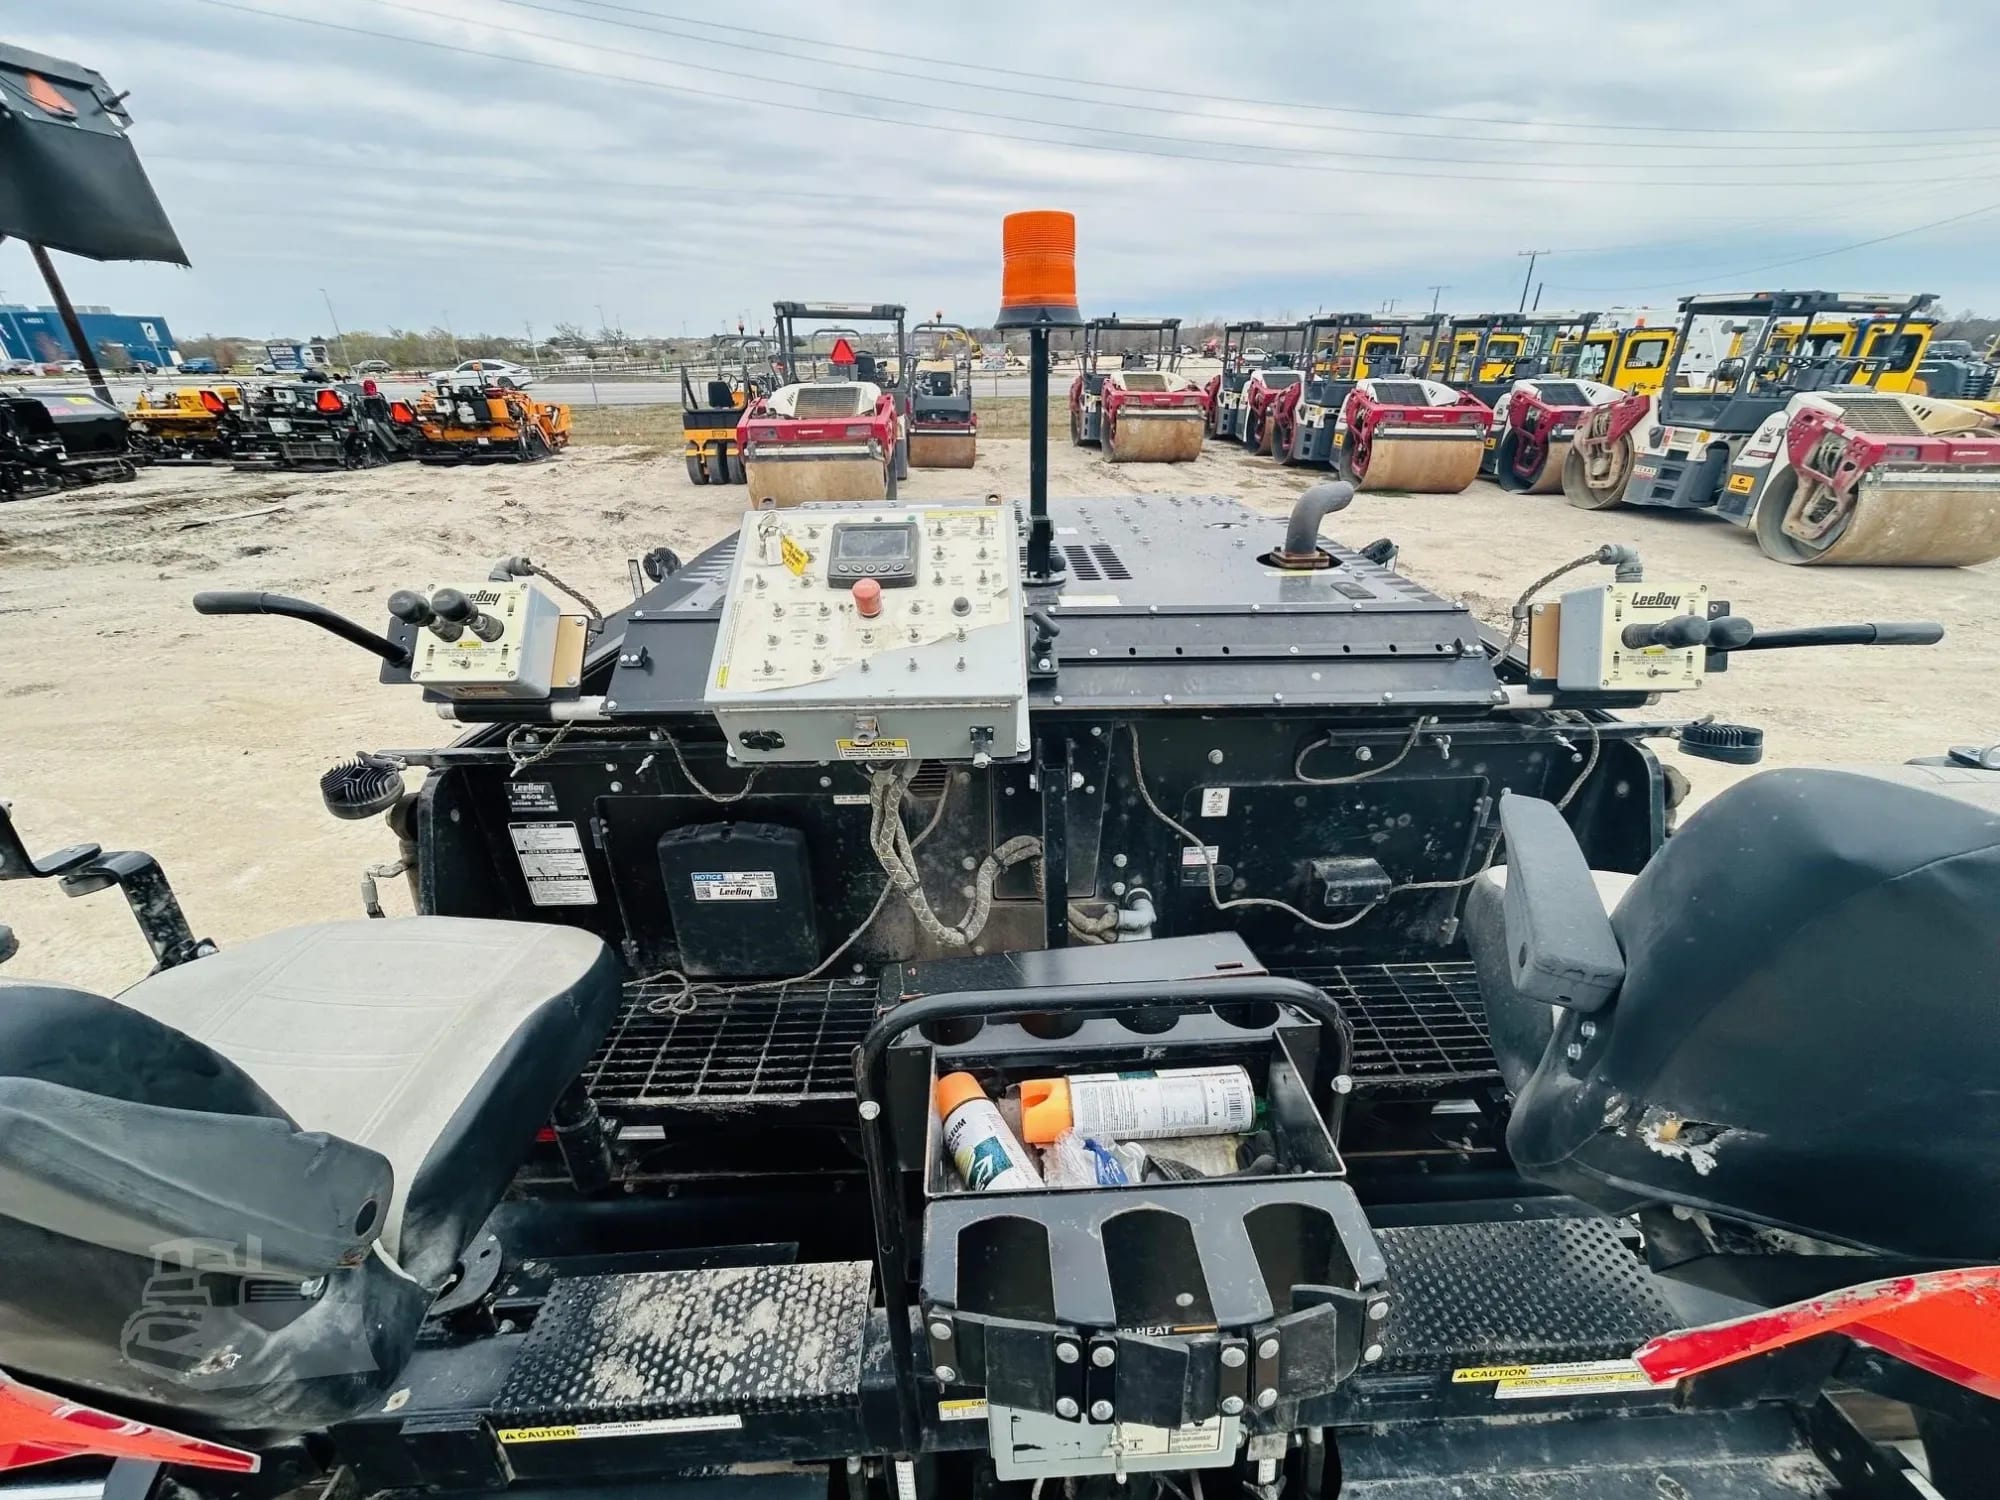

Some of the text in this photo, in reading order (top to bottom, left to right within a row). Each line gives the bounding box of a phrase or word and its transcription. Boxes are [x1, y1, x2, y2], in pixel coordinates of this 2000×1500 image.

[465, 590, 501, 606] eBoy
[1631, 592, 1680, 609] LeeBoy
[512, 783, 545, 793] LeeBoy
[719, 887, 753, 898] LeeBoy
[1136, 1325, 1171, 1336] HEAT
[1471, 1368, 1527, 1379] CAUTION
[517, 1428, 575, 1440] CAUTION
